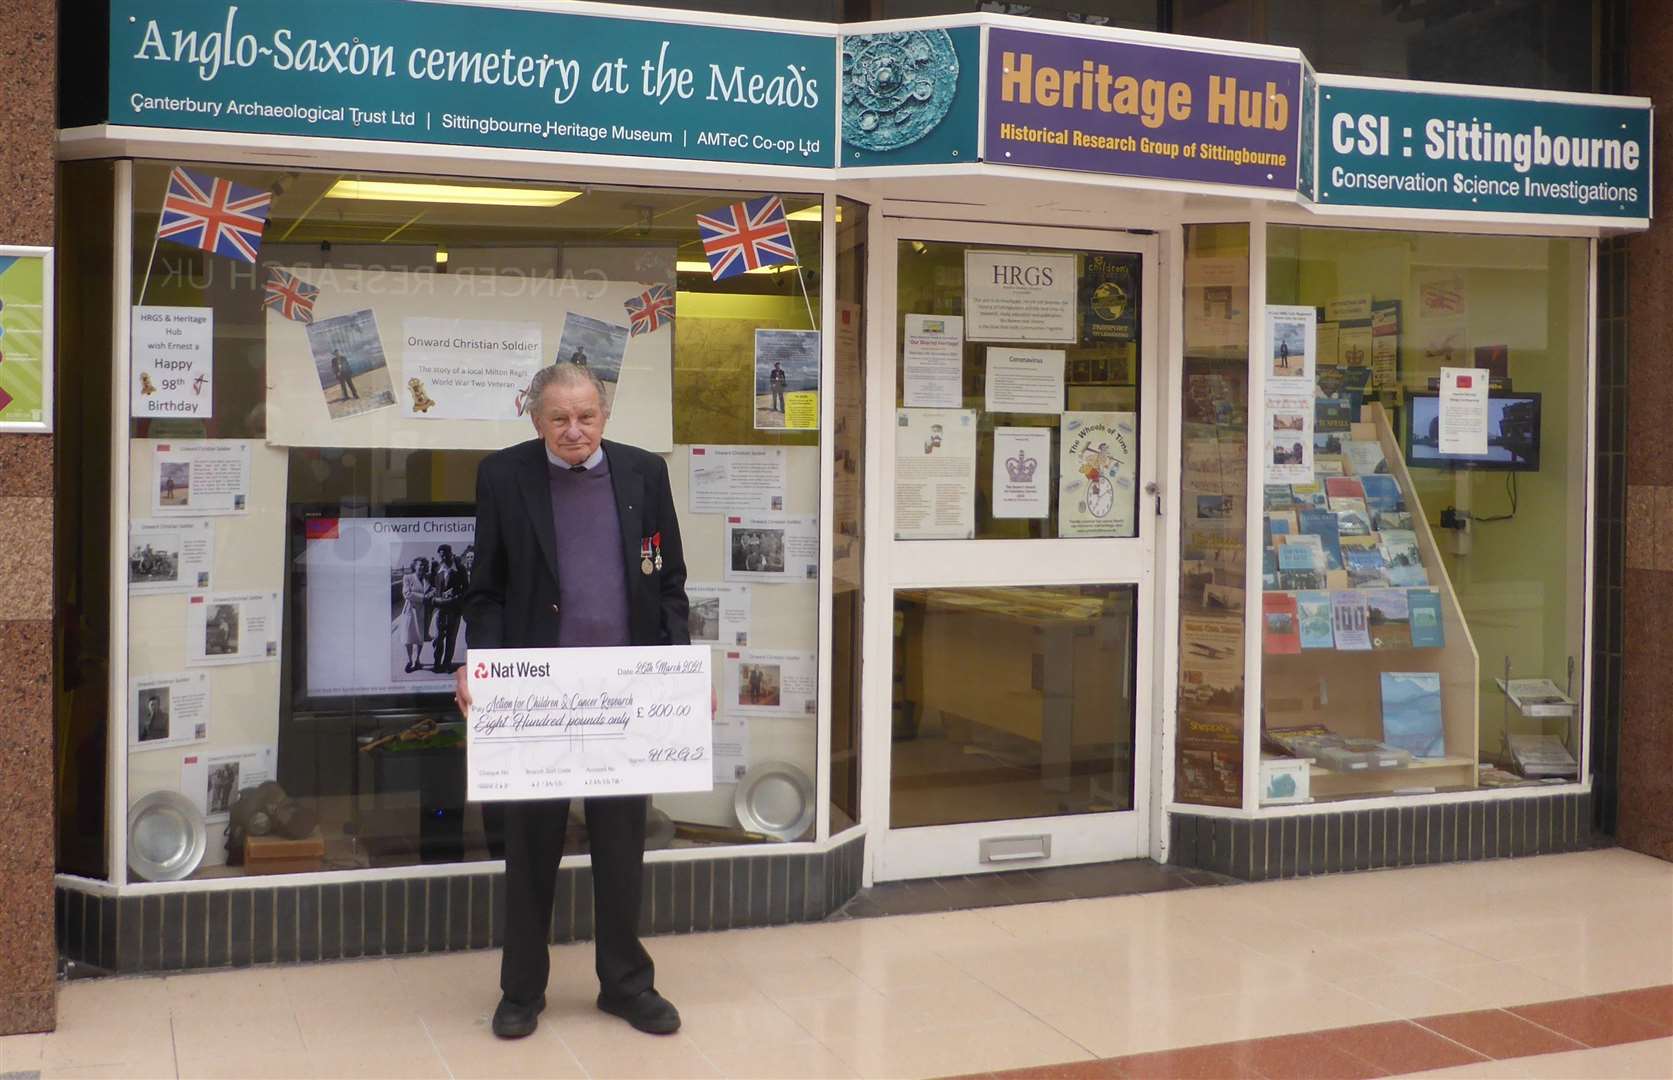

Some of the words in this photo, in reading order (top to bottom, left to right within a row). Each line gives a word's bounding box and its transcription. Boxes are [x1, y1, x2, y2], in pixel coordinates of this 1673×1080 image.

[408, 48, 580, 104] cemetery
[591, 58, 629, 94] at
[641, 41, 694, 105] the
[706, 64, 819, 109] Meads
[1002, 52, 1192, 128] Heritage
[1208, 75, 1288, 131] Hub
[130, 93, 222, 117] Canterbury
[226, 100, 344, 123] Archaeological
[350, 107, 387, 125] Trust
[391, 110, 415, 126] Ltd
[442, 113, 542, 134] Sittingbourne
[546, 120, 607, 140] Heritage
[612, 125, 673, 143] Museum
[697, 131, 749, 148] AMTeC
[752, 135, 794, 153] Co-op
[799, 138, 820, 153] Ltd
[1000, 123, 1069, 146] Historical
[1072, 130, 1137, 151] Research
[1140, 140, 1179, 159] Group
[1183, 143, 1196, 158] of
[1200, 144, 1287, 166] Sittingbourne
[1332, 112, 1389, 156] CSI
[1425, 118, 1640, 172] Sittingbourne
[1332, 166, 1447, 192] Conservation
[1453, 173, 1520, 196] Science
[1524, 177, 1638, 204] Investigations
[992, 264, 1053, 287] HRGS
[141, 314, 163, 323] HRGS
[174, 315, 207, 324] Heritage
[166, 328, 183, 336] Hub
[148, 342, 166, 350] wish
[168, 342, 193, 351] Ernest
[408, 336, 450, 348] Onward
[453, 338, 499, 350] Christian
[501, 340, 538, 351] Soldier
[154, 358, 193, 371] Happy
[162, 378, 185, 390] 98th
[148, 400, 199, 412] Birthday
[1069, 437, 1080, 455] The
[1078, 423, 1105, 439] Wheels
[373, 521, 420, 533] Onward
[423, 521, 475, 533] Christian
[527, 694, 559, 711] Children
[473, 713, 508, 736] Eight
[512, 712, 566, 730] Hundred
[565, 712, 606, 732] pounds
[608, 712, 630, 731] only
